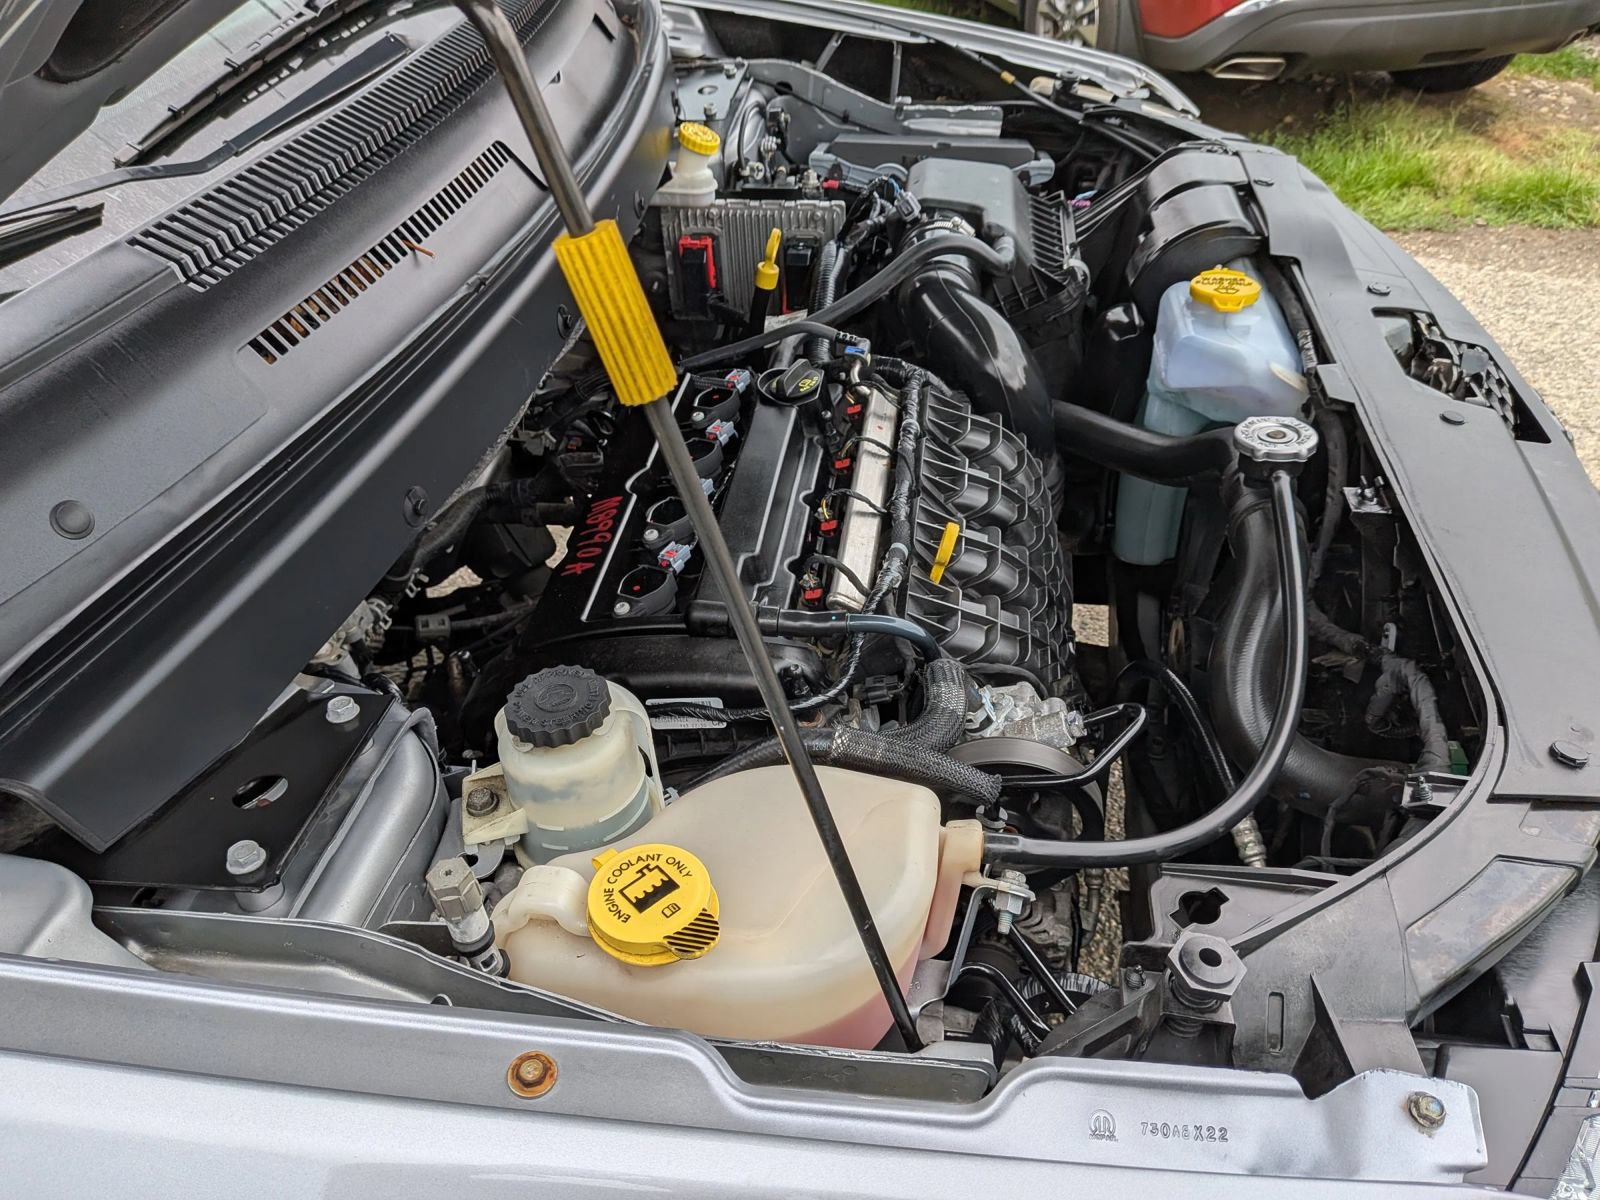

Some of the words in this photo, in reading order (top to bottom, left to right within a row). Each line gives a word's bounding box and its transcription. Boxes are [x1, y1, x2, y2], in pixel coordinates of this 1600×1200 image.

[607, 853, 663, 884] COOLANT
[665, 856, 693, 878] ONLY
[603, 887, 631, 924] ENGINE
